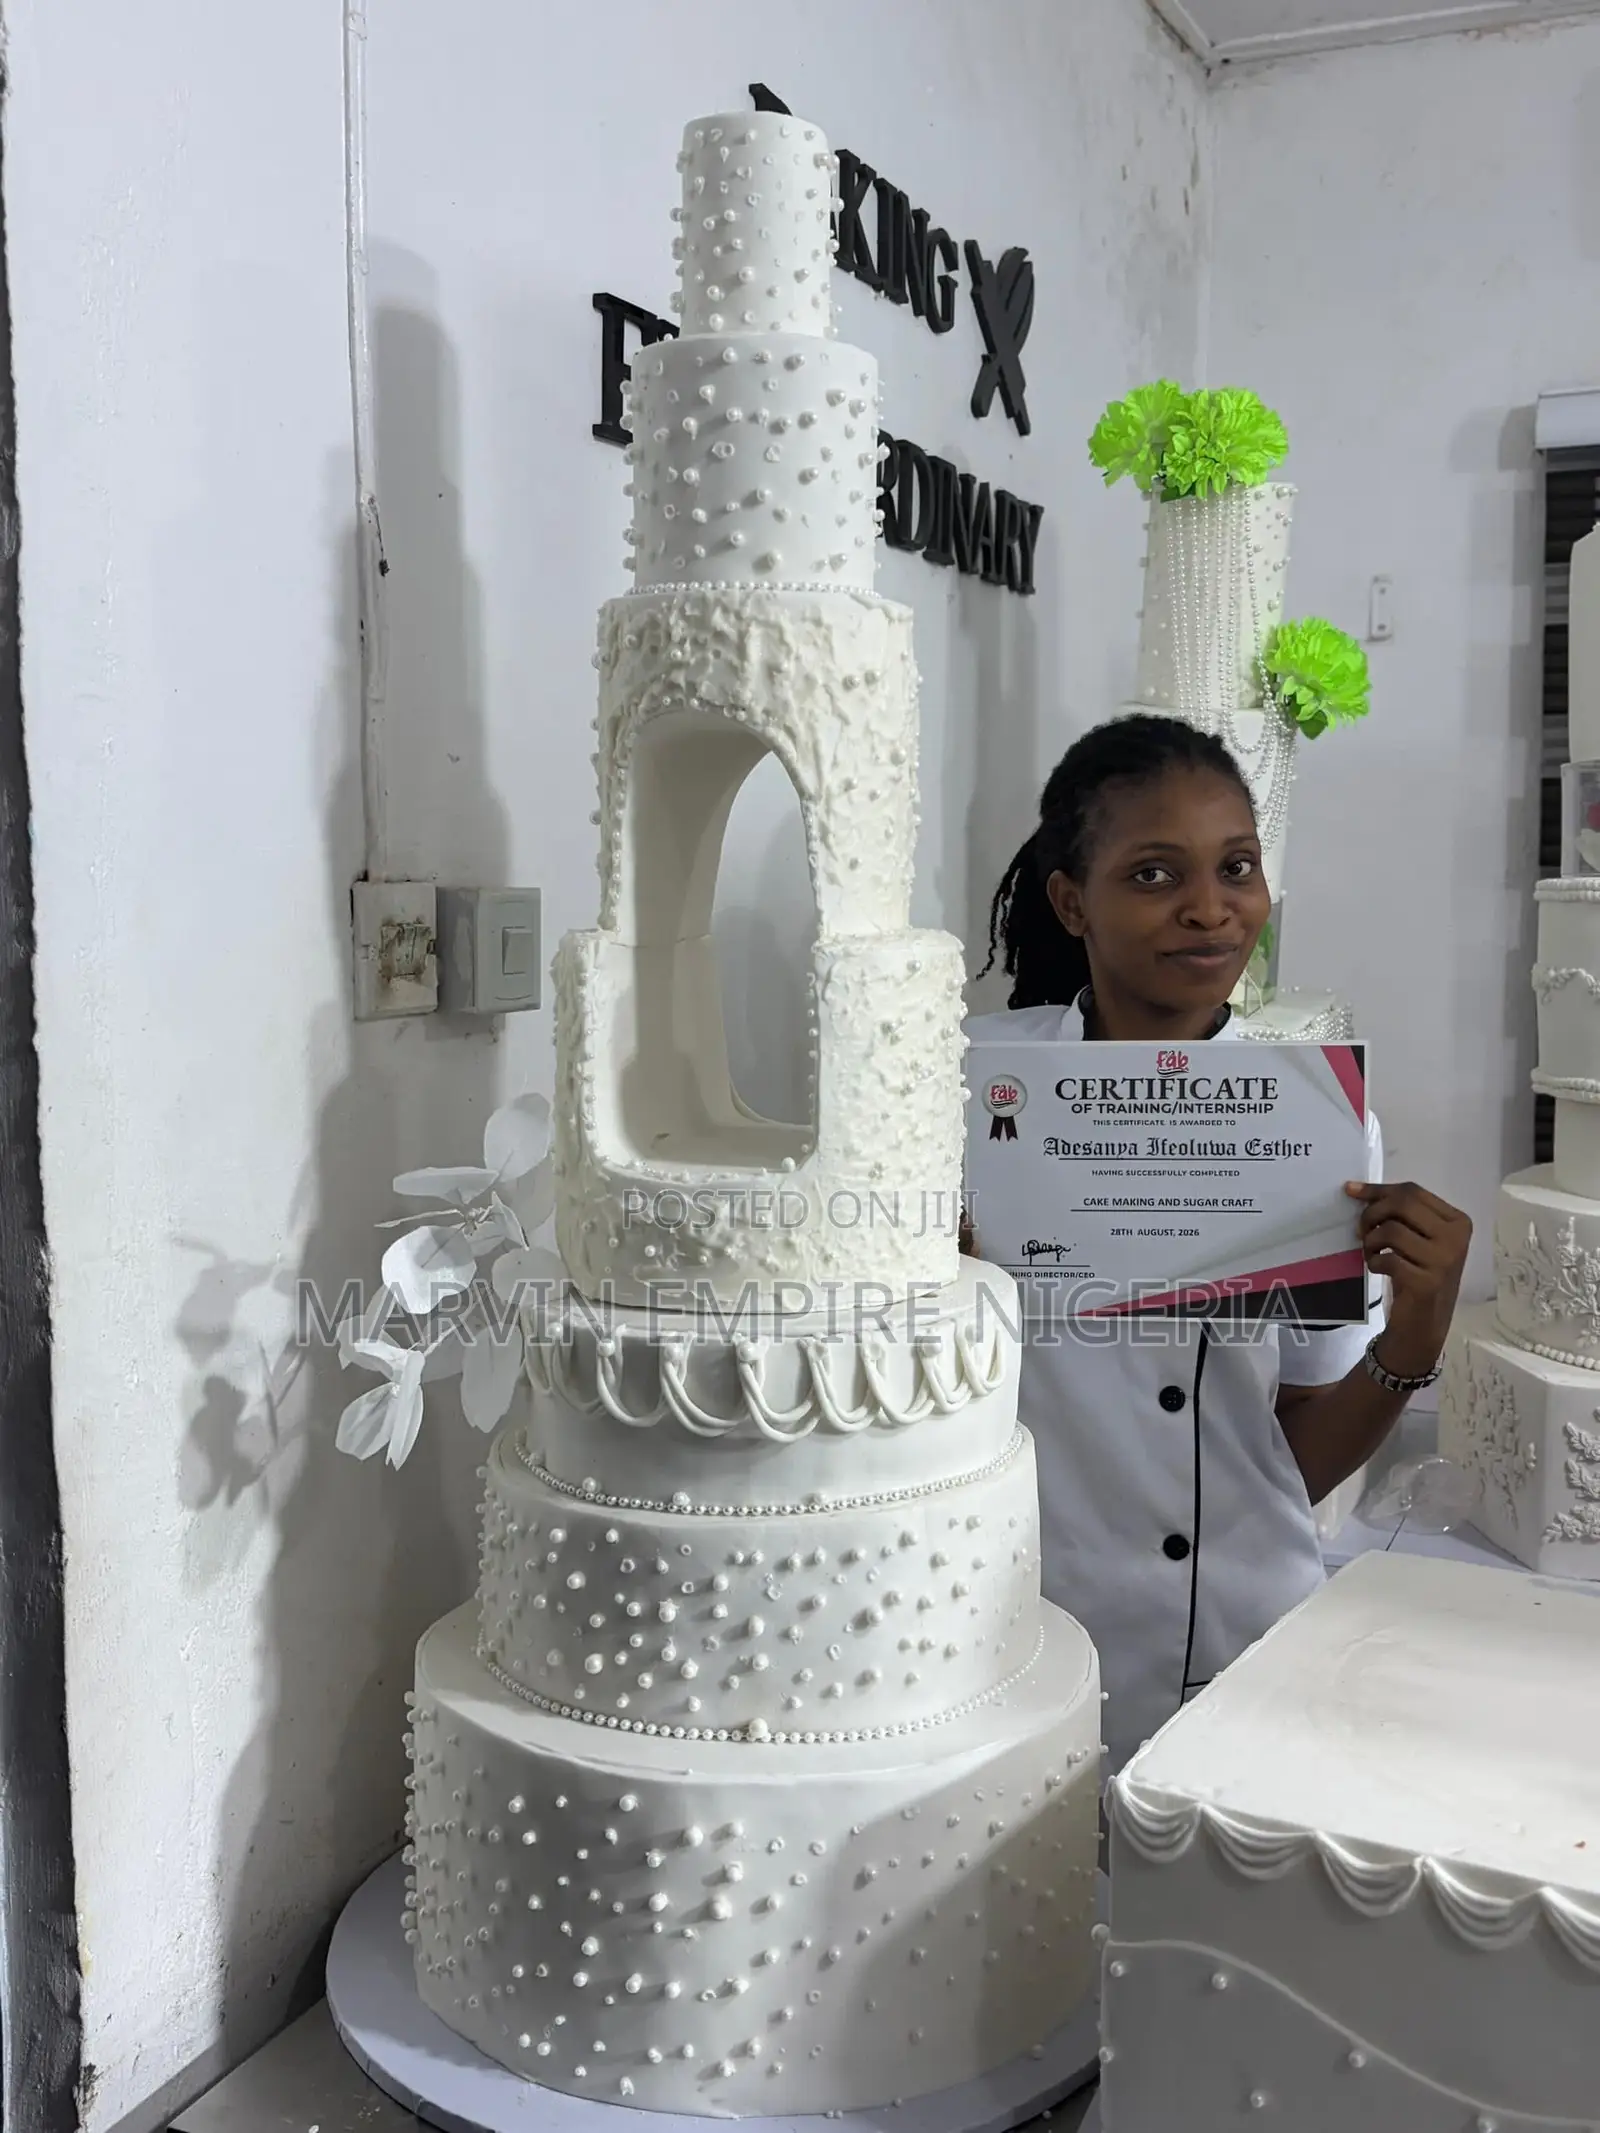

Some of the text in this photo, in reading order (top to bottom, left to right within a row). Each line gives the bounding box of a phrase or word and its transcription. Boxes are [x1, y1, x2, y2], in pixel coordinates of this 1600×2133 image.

[1055, 1077, 1279, 1101] CERTIFICATE
[1071, 1101, 1274, 1115] OF TRAINING/INTERNSHIP
[1113, 1119, 1165, 1127] CERTIFICATE
[1179, 1119, 1222, 1127] AWARDED
[1224, 1119, 1237, 1127] TO
[1043, 1137, 1313, 1160] Adesanya Ifeoluwa Esther
[1091, 1169, 1241, 1177] HAVING SUCCESSFULLY COMPLETED
[1083, 1197, 1255, 1208] CAKE MAKING AND SUGAR CRAFT
[1110, 1228, 1200, 1238] 28TH AUGUST, 2026
[1034, 1271, 1095, 1279] DIRECTOR/CEO
